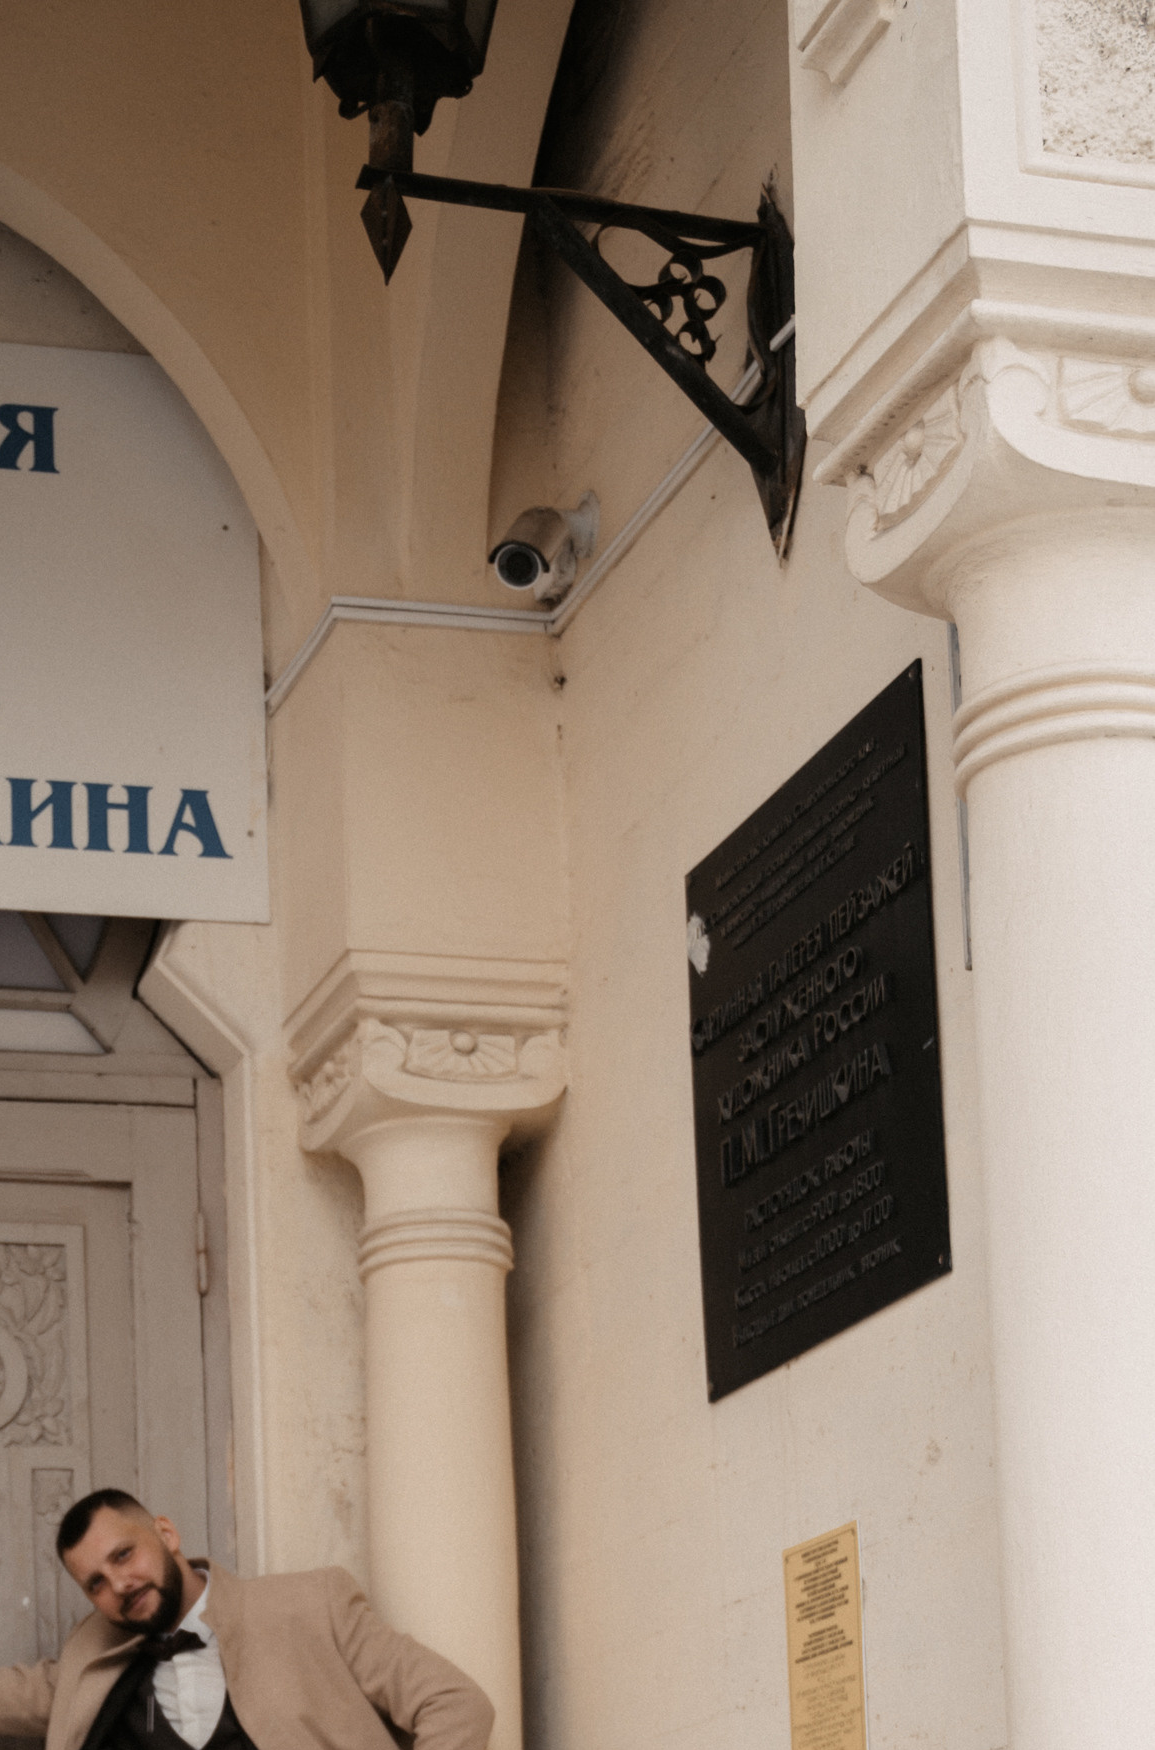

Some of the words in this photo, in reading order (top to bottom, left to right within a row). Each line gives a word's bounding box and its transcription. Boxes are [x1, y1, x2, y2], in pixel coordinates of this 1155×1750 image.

[768, 922, 822, 993] ГАЛЕРЕЯ
[827, 842, 914, 941] ПЕЙЗАЖЕЙ
[716, 1029, 807, 1127] ХУДОЖНИКА
[813, 972, 885, 1052] РОССИИ
[735, 940, 859, 1066] ЗАСЛУЖЕННОГО
